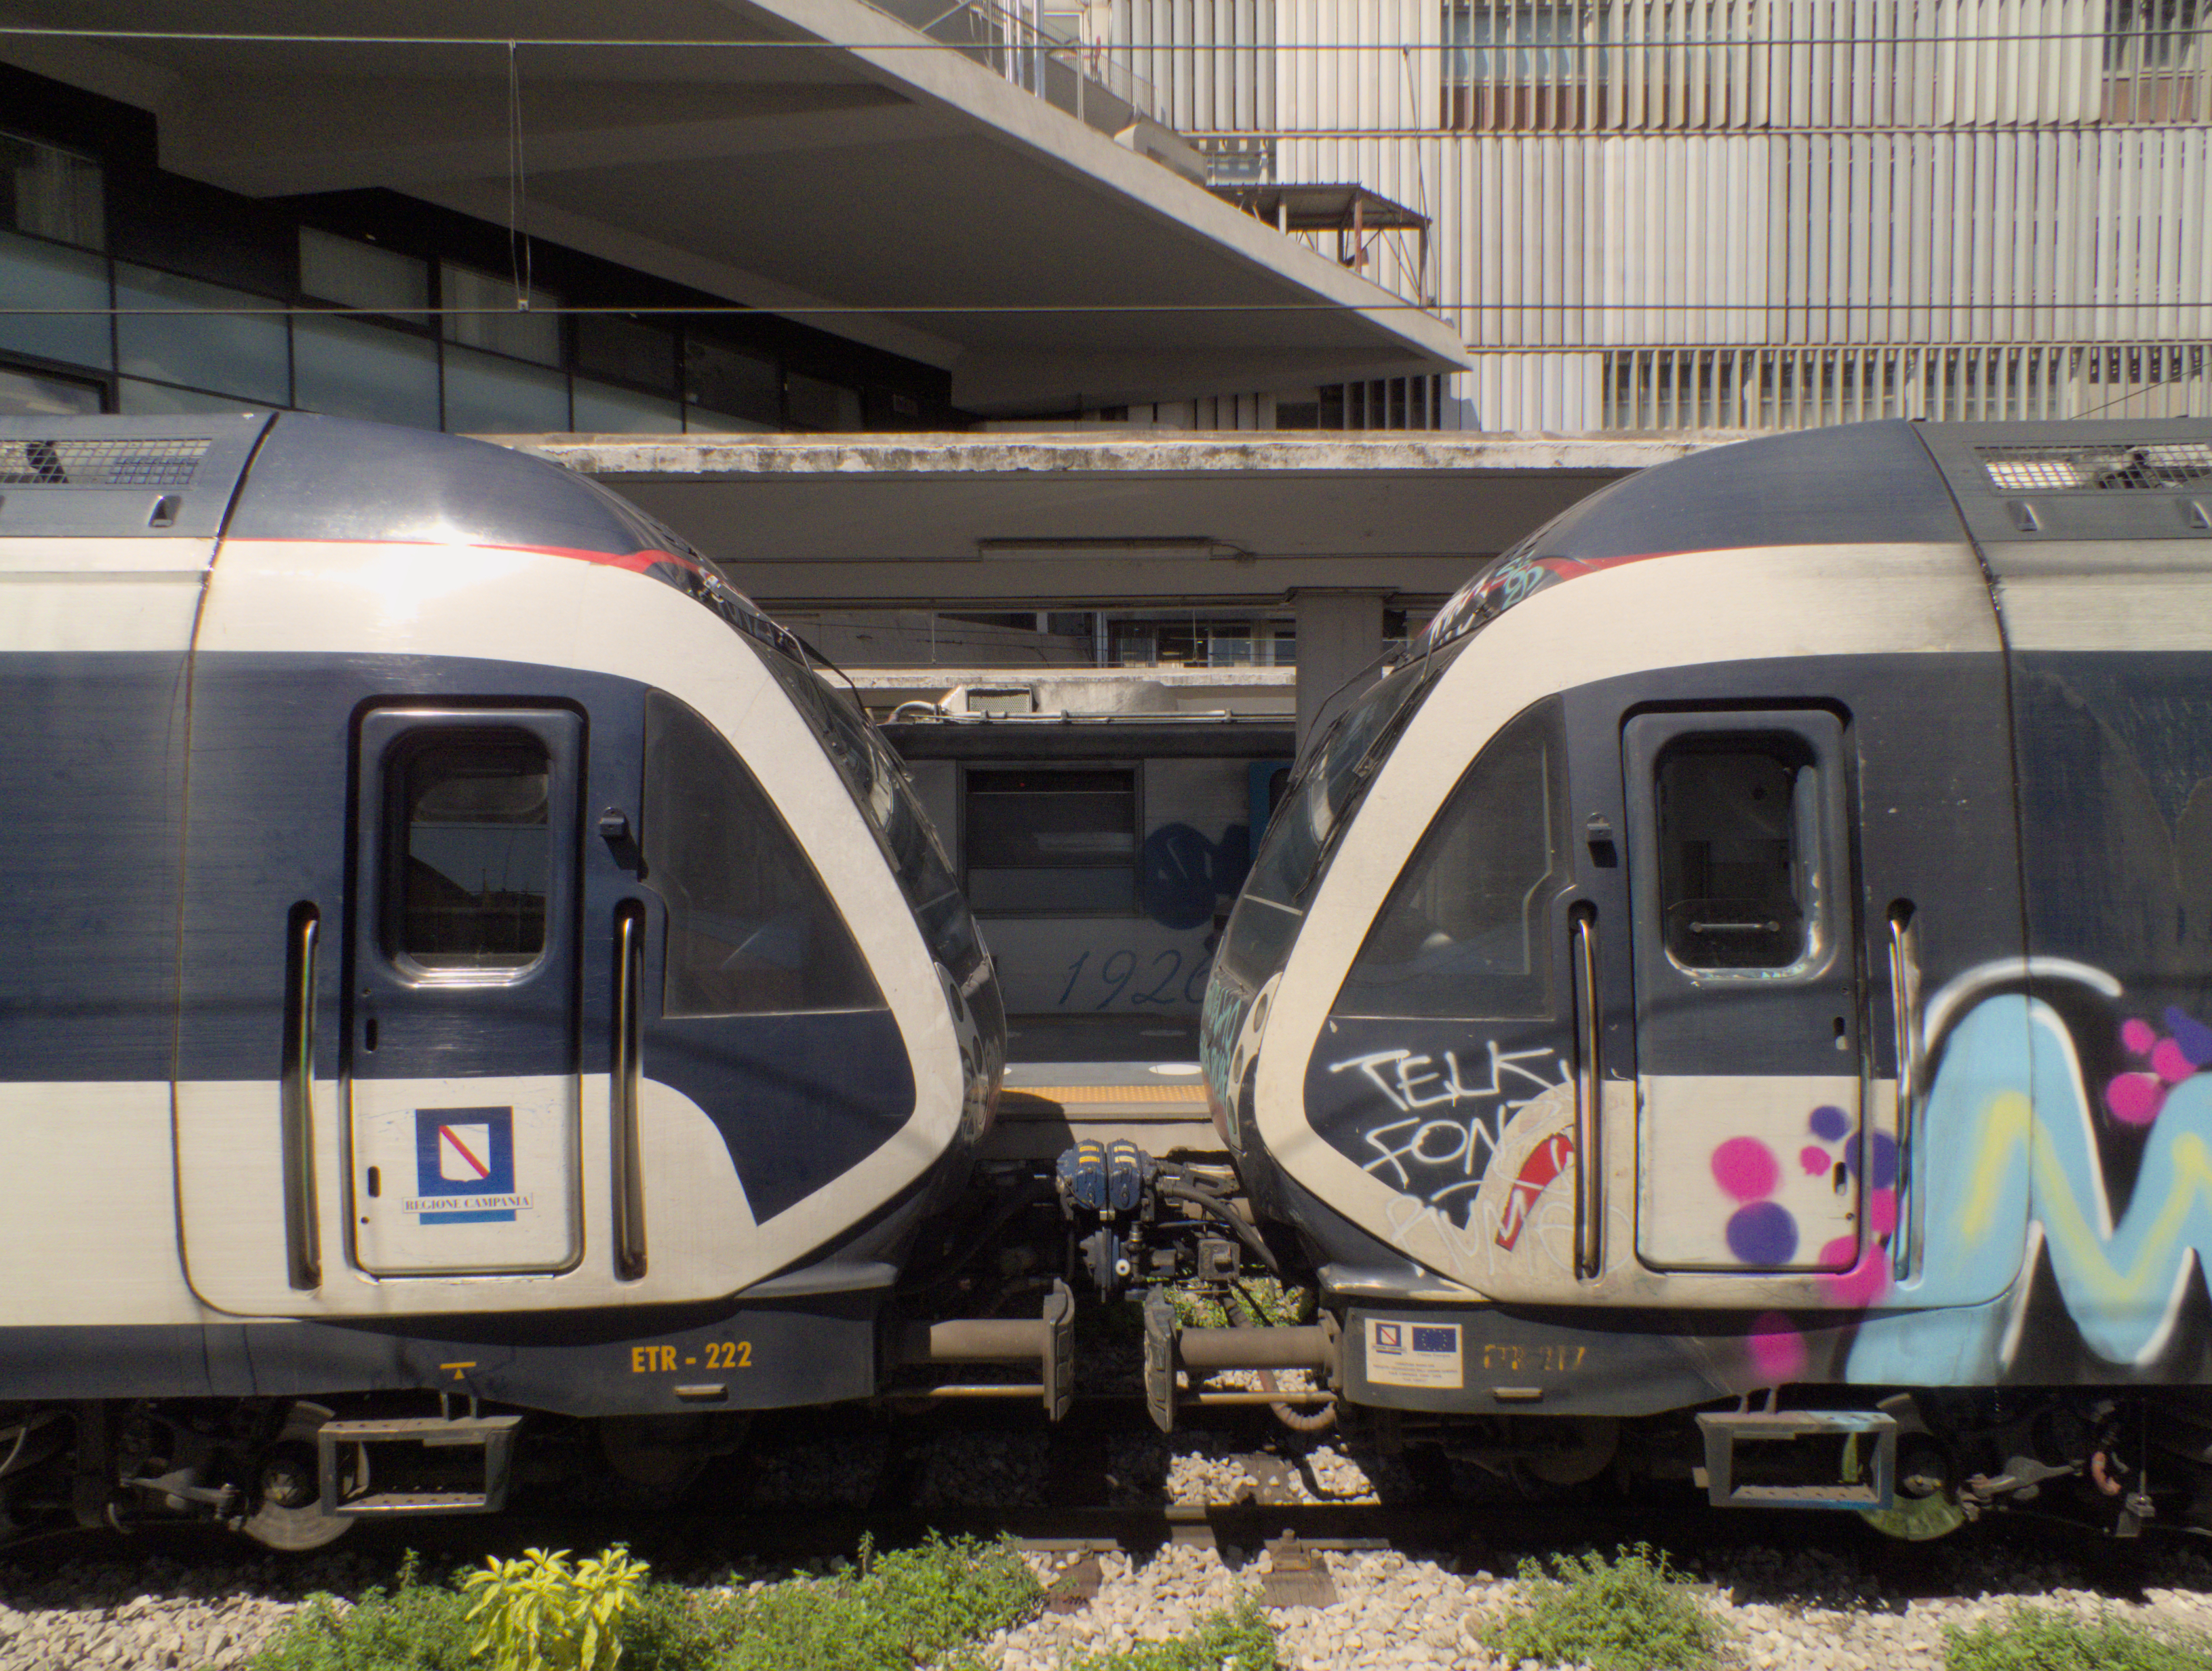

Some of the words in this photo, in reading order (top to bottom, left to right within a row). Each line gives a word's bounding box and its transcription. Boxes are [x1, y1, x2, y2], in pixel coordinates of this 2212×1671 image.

[406, 1198, 461, 1211] REGIONE
[464, 1196, 530, 1208] CAMPANIA
[632, 1345, 677, 1373] ETR
[705, 1341, 752, 1369] 222
